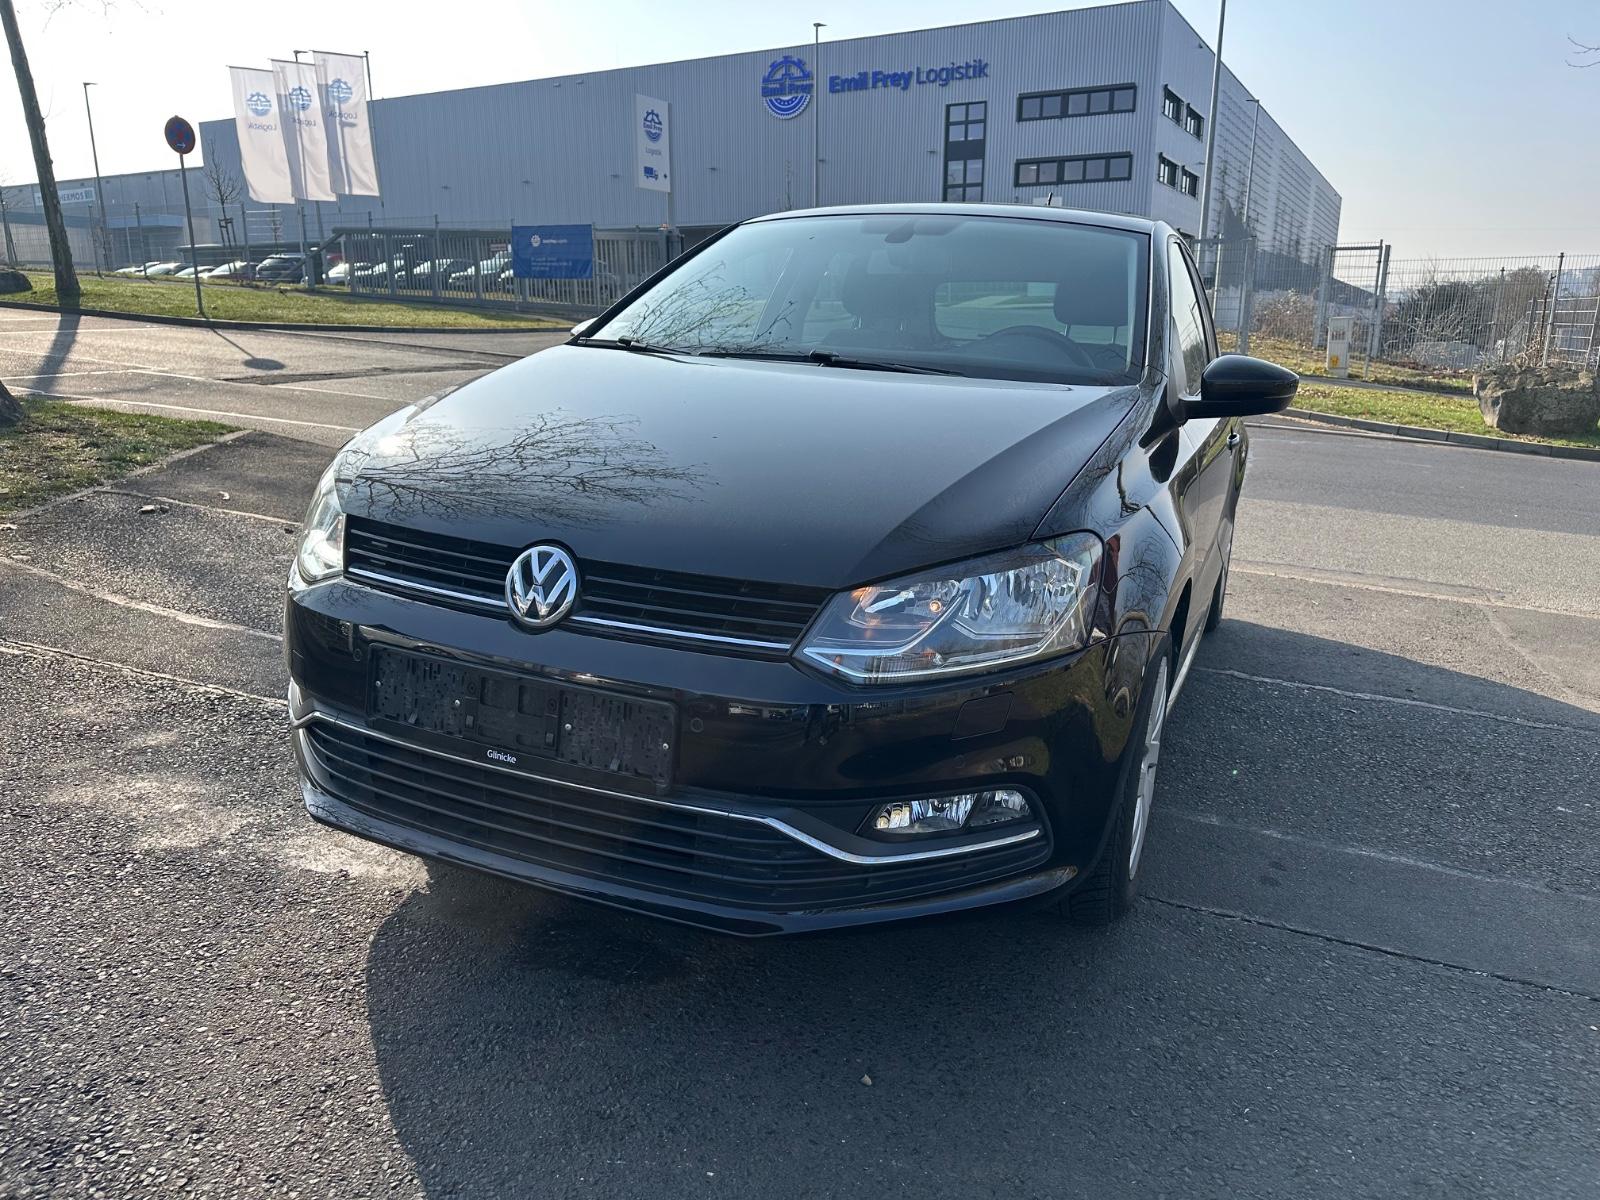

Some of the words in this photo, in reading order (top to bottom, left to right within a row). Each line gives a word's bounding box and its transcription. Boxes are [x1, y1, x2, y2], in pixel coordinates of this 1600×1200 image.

[829, 72, 868, 94] Emil
[871, 70, 913, 91] Frey
[916, 58, 989, 87] Logistik
[508, 547, 575, 622] VW
[486, 749, 517, 764] Glinicke
